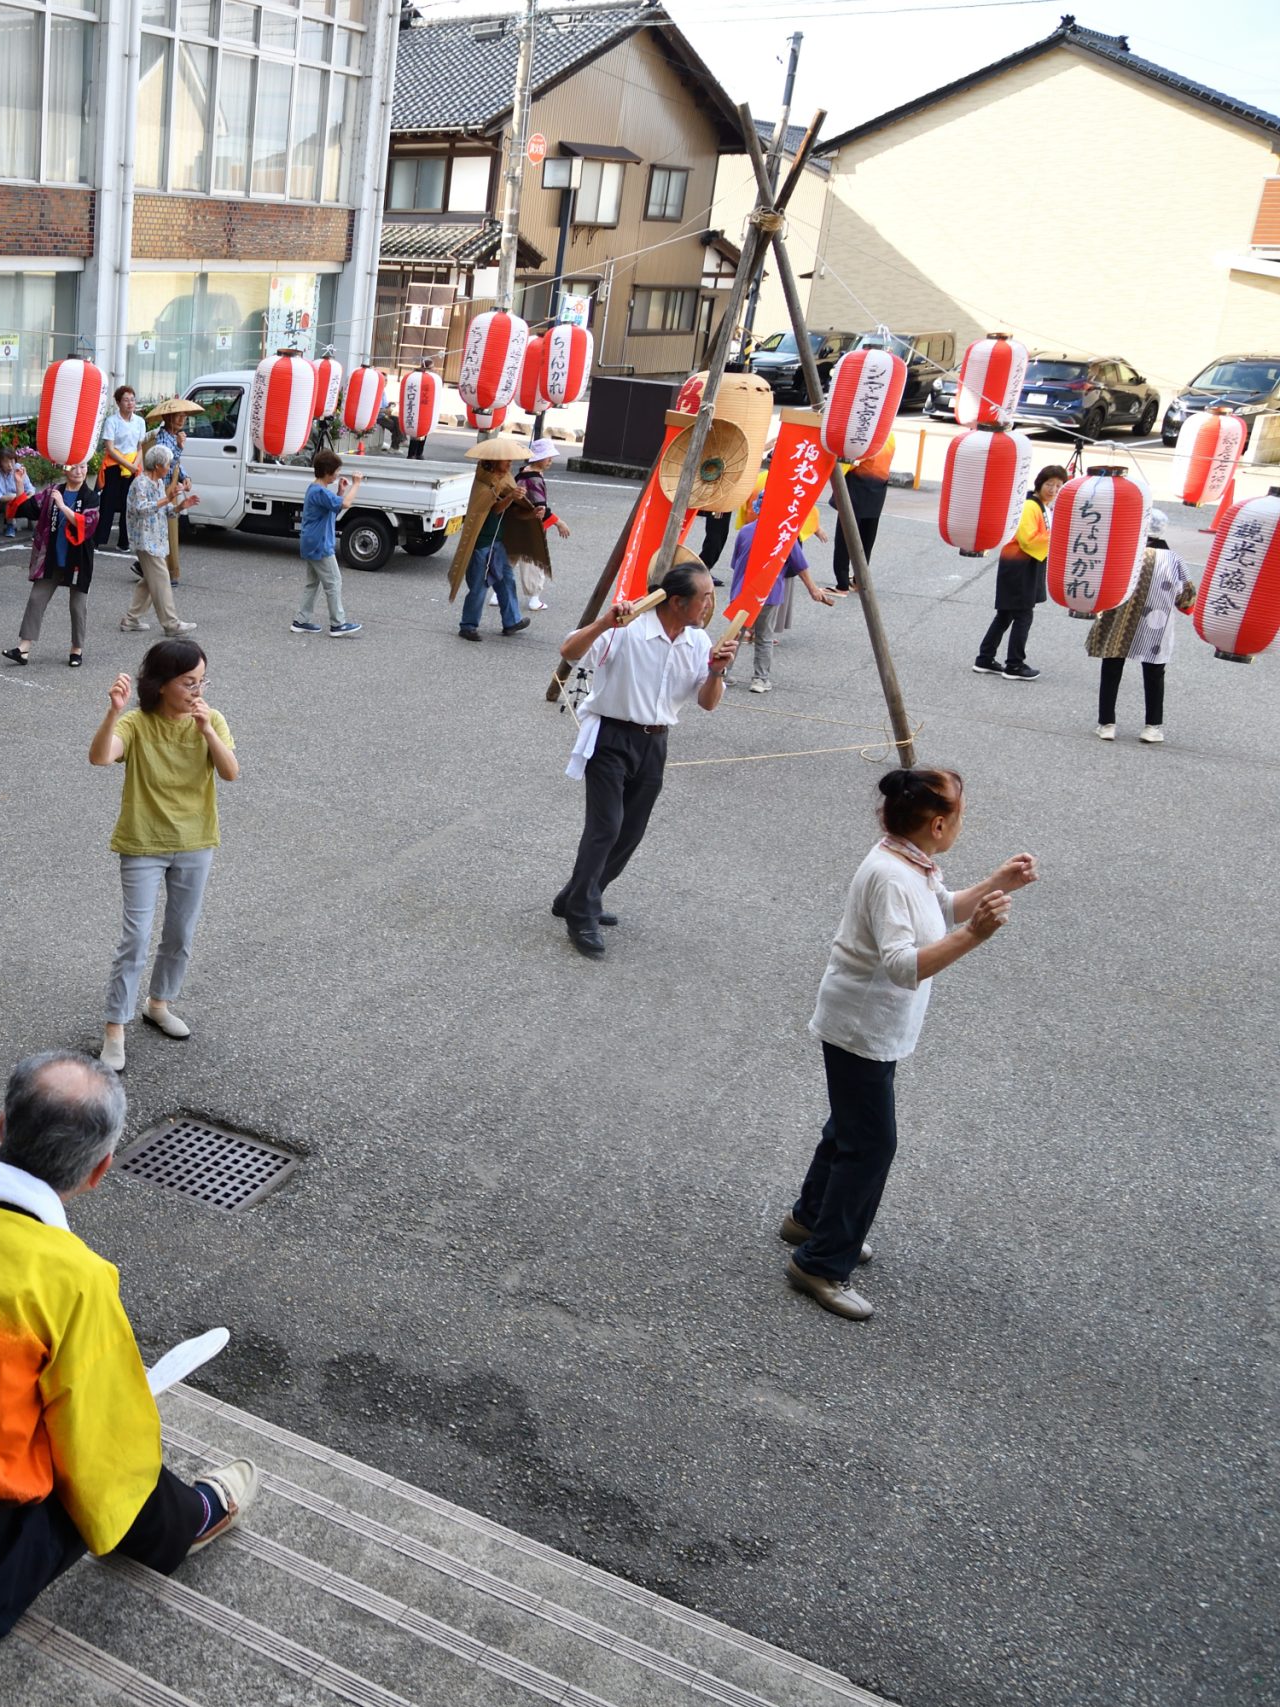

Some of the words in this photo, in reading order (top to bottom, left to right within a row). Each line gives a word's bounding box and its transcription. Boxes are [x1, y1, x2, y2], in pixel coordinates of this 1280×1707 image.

[460, 326, 483, 395] ちょんがれ
[549, 336, 566, 396] ちょんがれ
[1065, 500, 1102, 599] ちょんがれ
[1210, 518, 1265, 617] 観光協会
